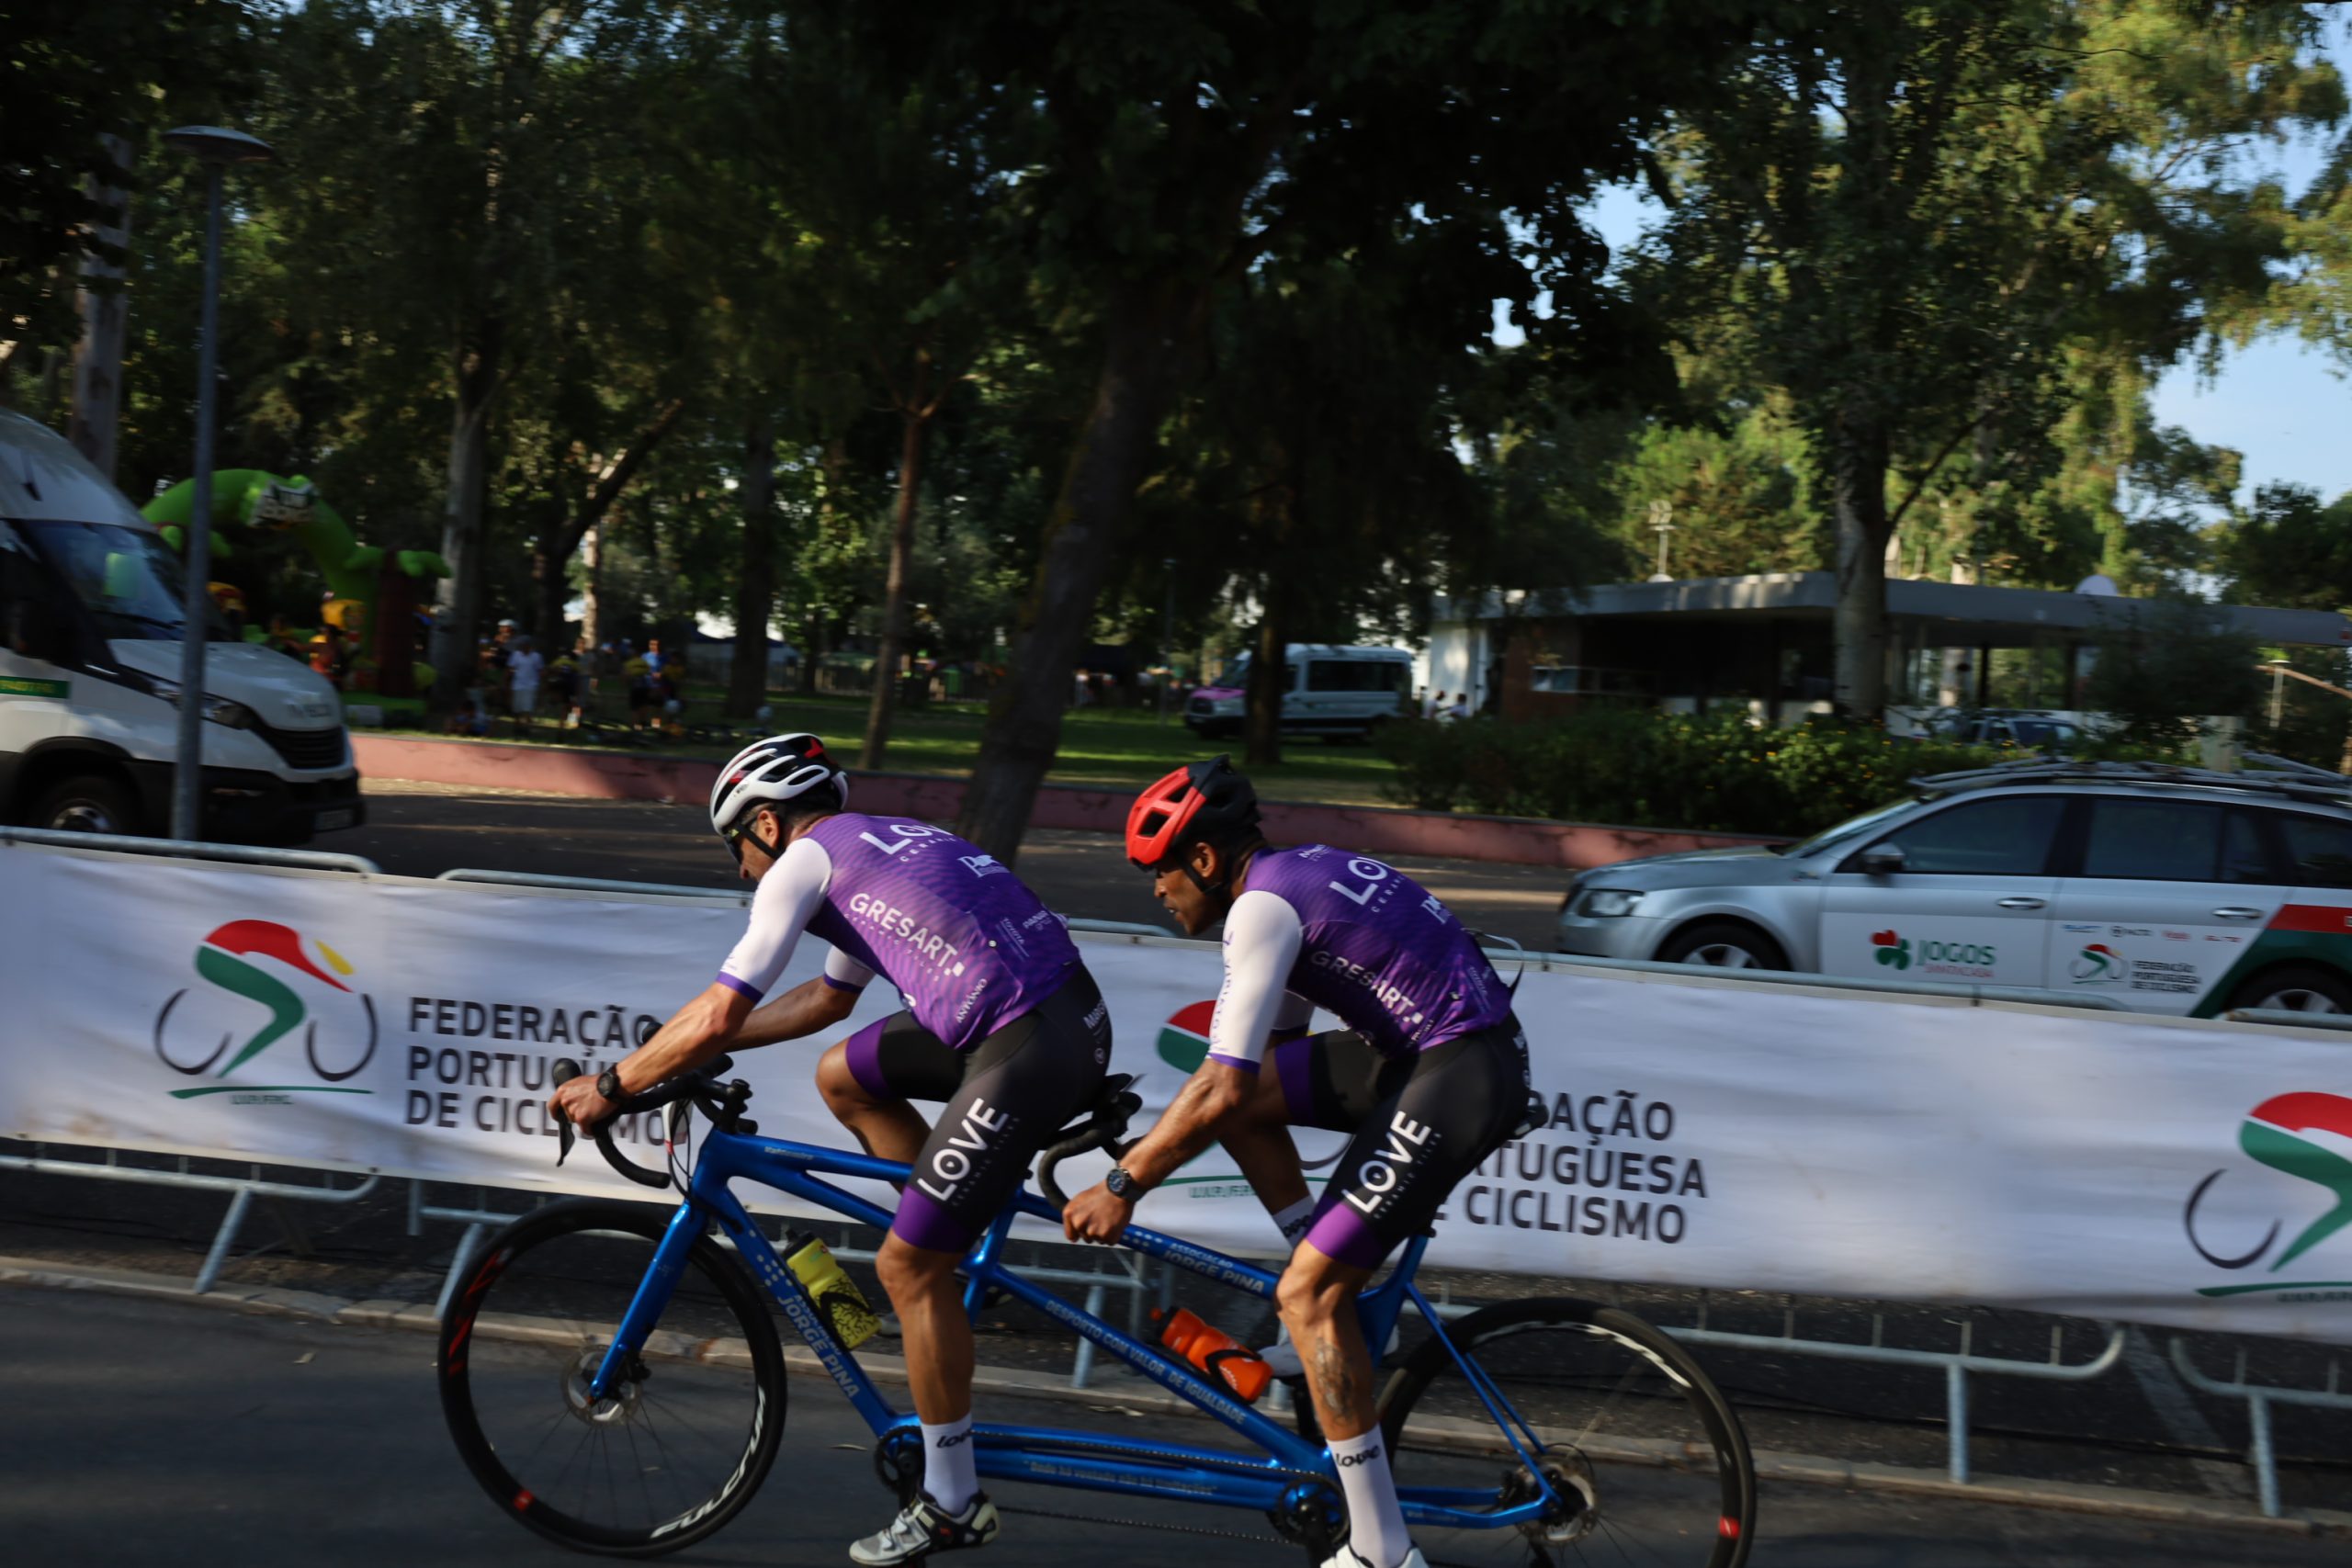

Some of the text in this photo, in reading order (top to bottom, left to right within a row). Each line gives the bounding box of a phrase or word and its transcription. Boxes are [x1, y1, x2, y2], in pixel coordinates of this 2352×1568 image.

[849, 892, 957, 968] GRESART
[1917, 940, 1996, 965] JOGOS
[405, 1089, 461, 1128] DE
[917, 1098, 1010, 1201] LOVE
[1341, 1111, 1431, 1213] LOVE
[1465, 1185, 1685, 1244] CICLISMO
[1163, 1249, 1265, 1293] JORGE PINA
[778, 1296, 860, 1399] JORGE PINA
[1045, 1299, 1103, 1339] DESPORTO
[1102, 1331, 1129, 1355] COM
[1129, 1342, 1166, 1375] VALOR
[1168, 1369, 1184, 1388] DE
[1183, 1380, 1248, 1425] IGUALDADE
